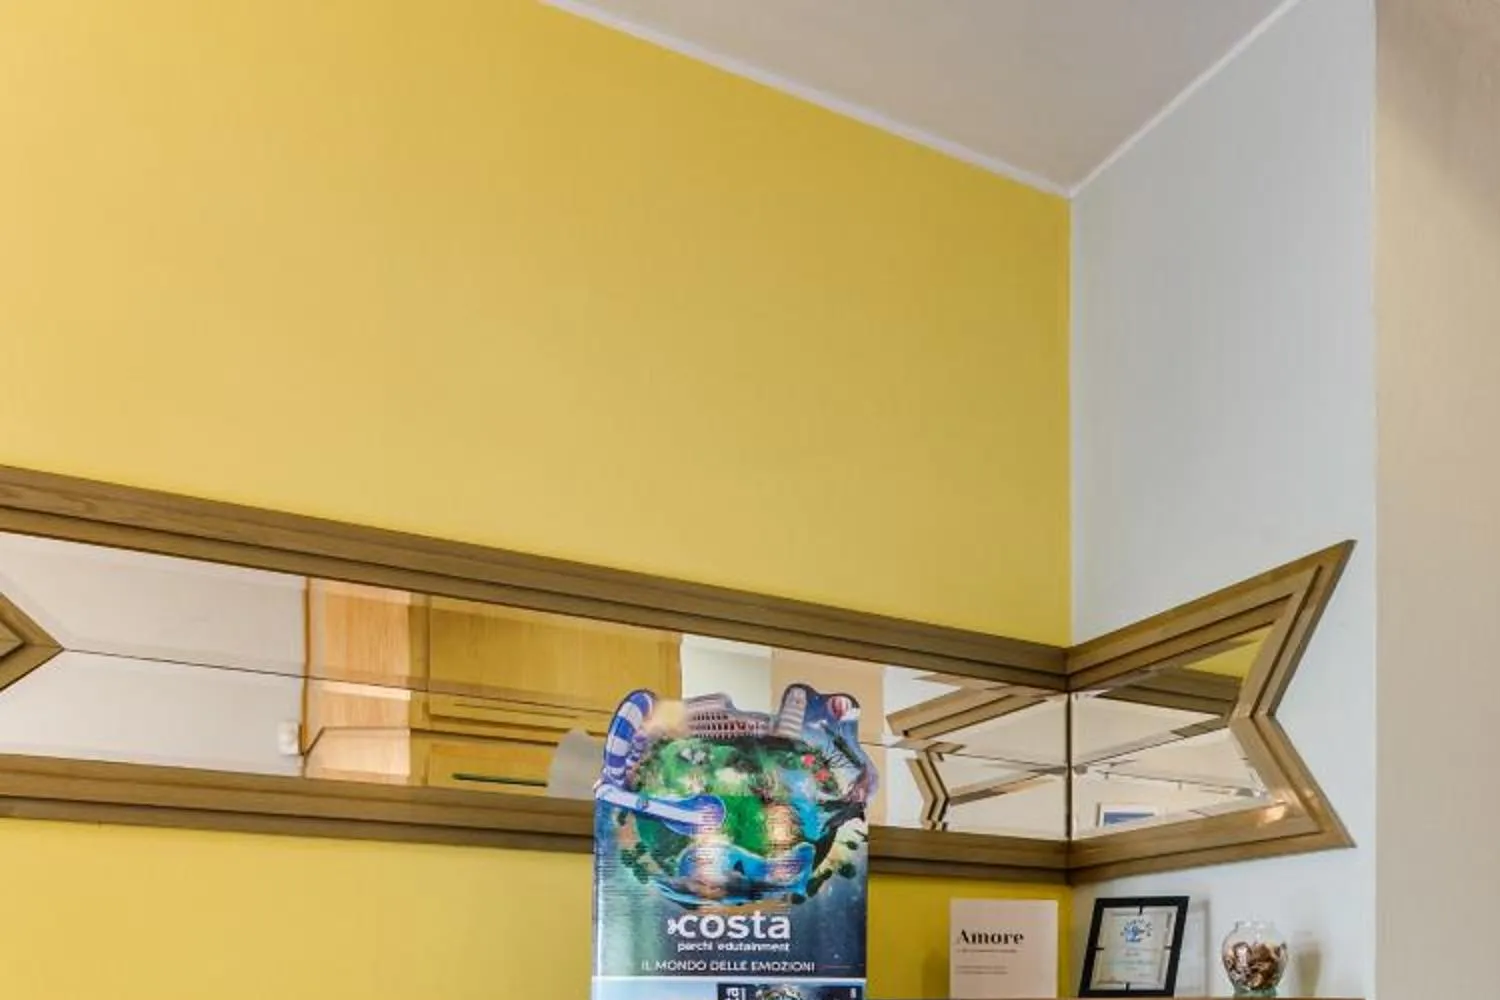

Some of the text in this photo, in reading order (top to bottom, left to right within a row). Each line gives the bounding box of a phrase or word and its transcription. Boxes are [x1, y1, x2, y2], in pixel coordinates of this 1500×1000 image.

[679, 910, 791, 939] costa
[956, 929, 1024, 945] Amore
[677, 941, 790, 953] parchi edutainment
[655, 960, 706, 971] MONDO
[710, 961, 748, 971] DELLE
[751, 961, 815, 972] EMOZIONI
